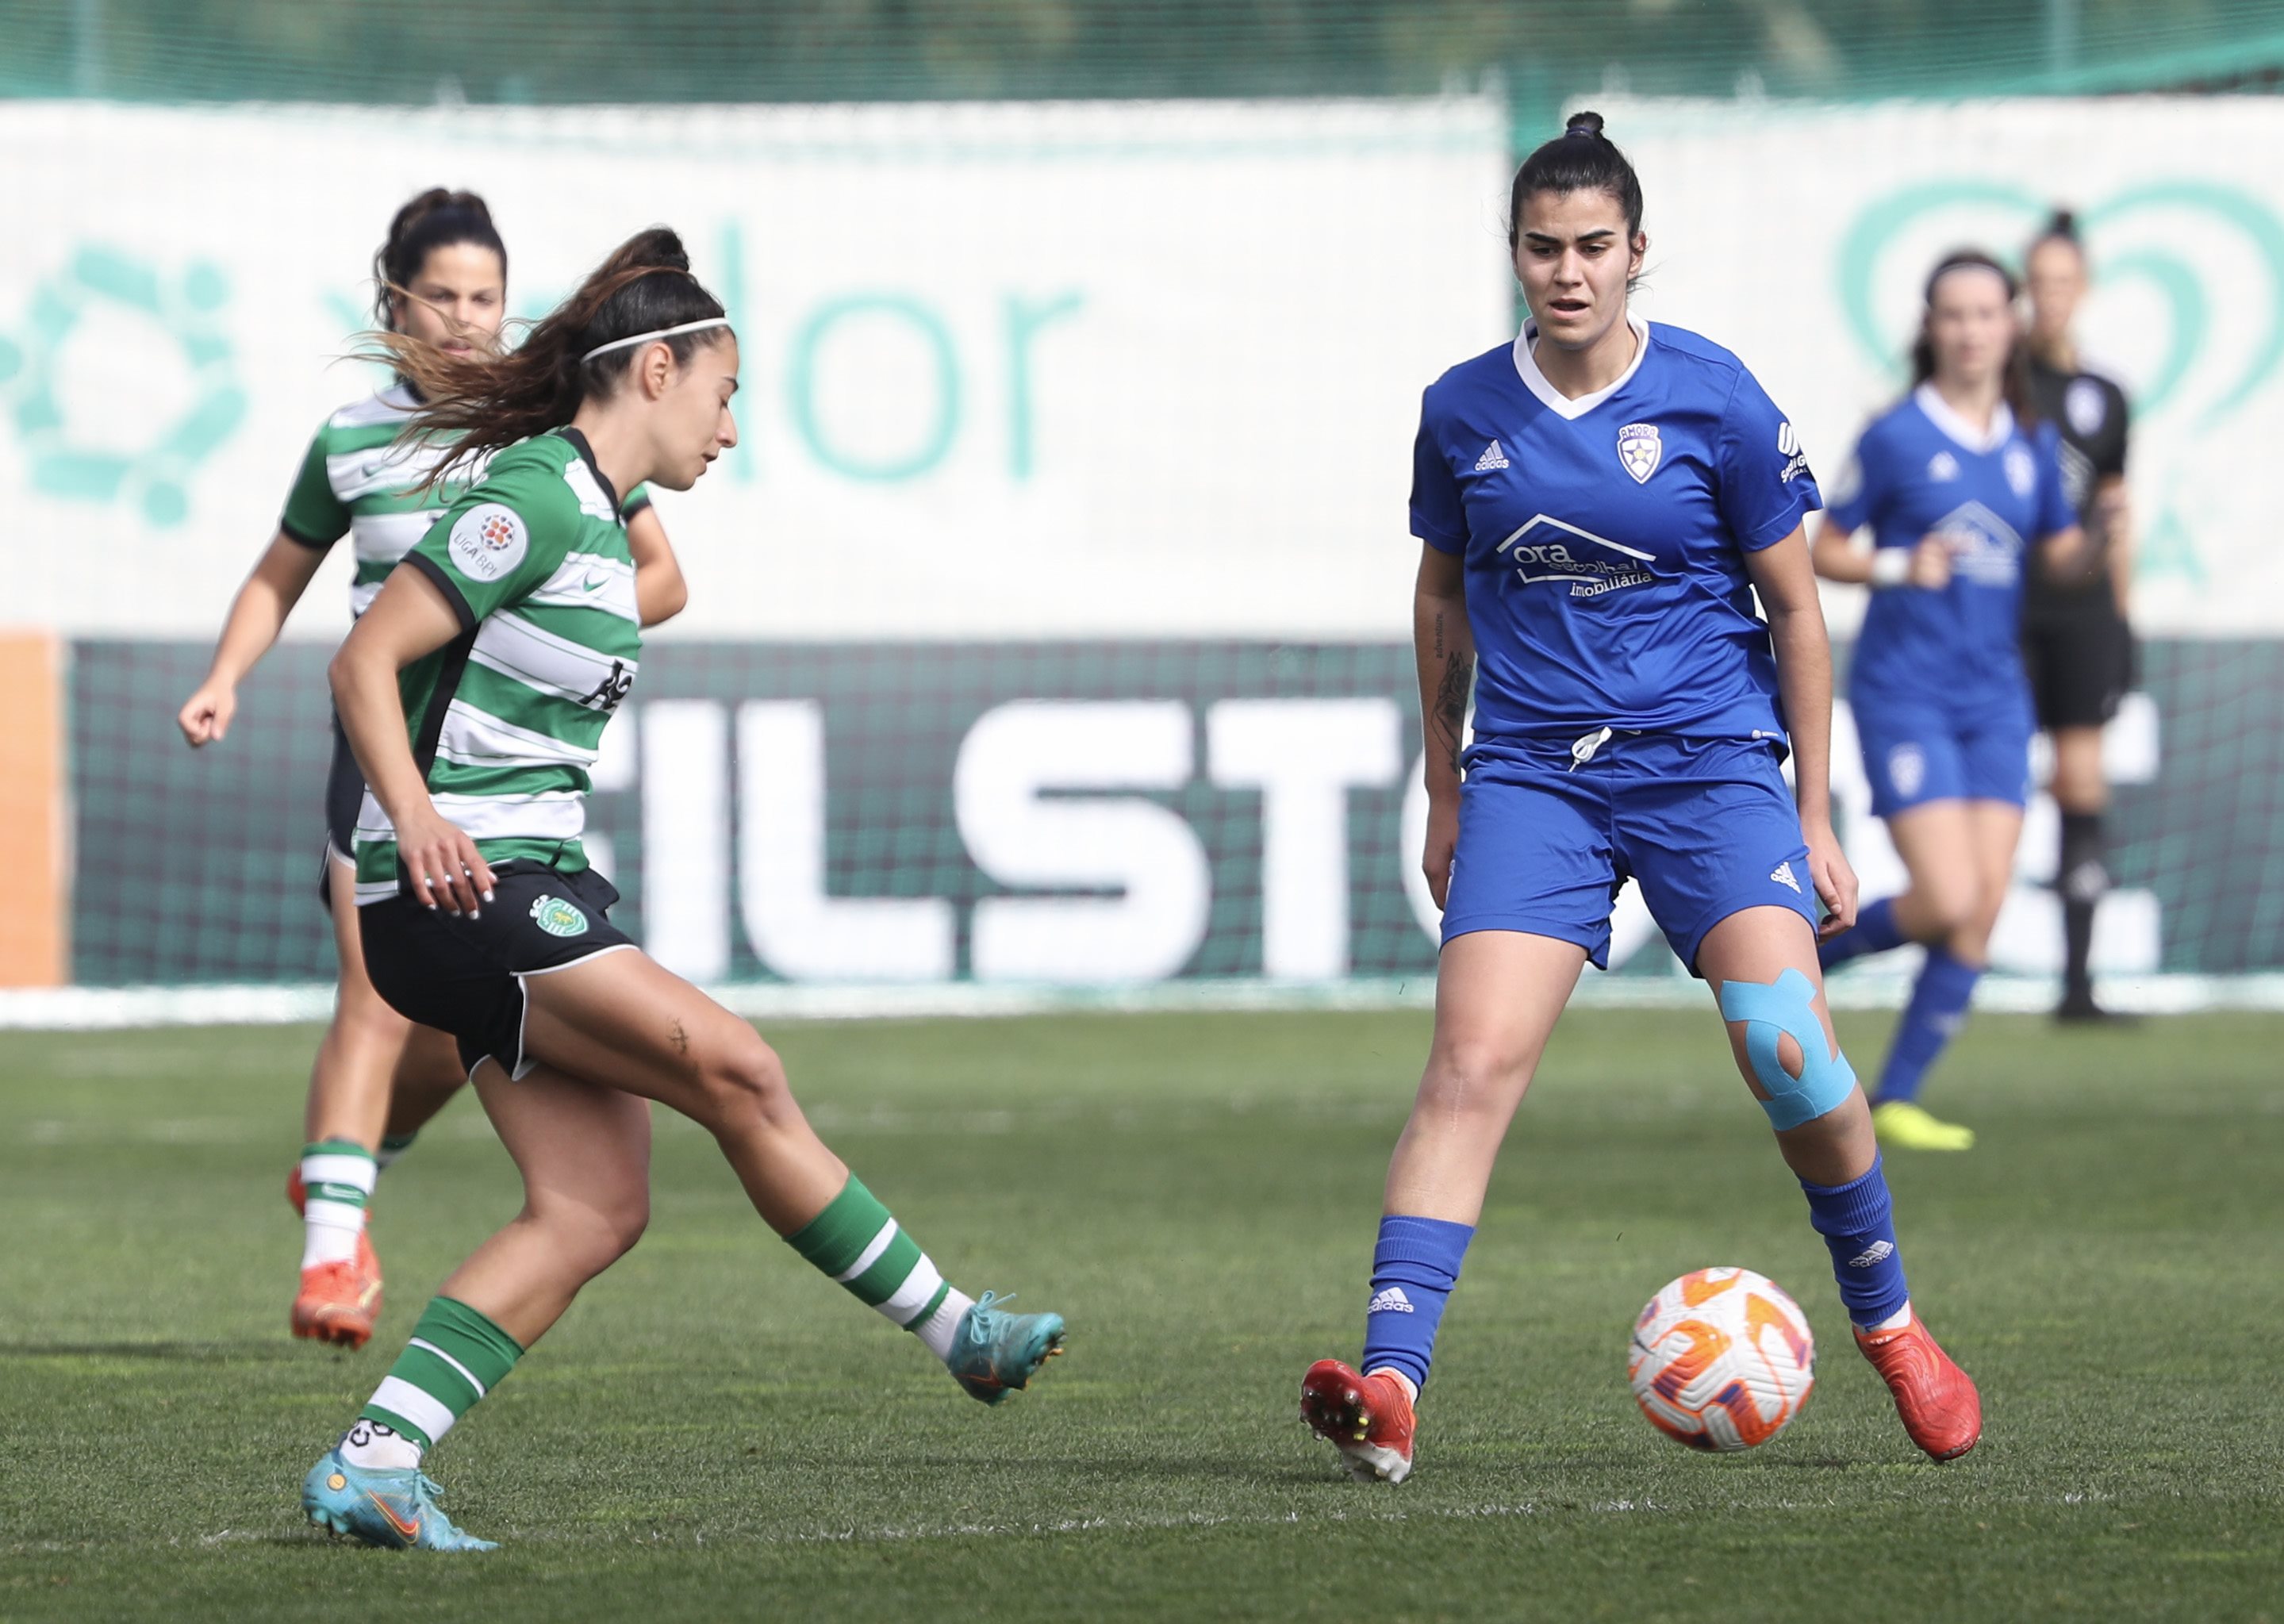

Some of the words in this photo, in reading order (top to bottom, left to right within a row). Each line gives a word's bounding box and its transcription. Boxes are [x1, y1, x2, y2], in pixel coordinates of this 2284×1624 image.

[1475, 457, 1510, 471] adidas
[453, 532, 478, 559] LIGA
[476, 554, 497, 578] BPI
[1513, 543, 1576, 564] ora
[1569, 570, 1653, 597] imobiliária
